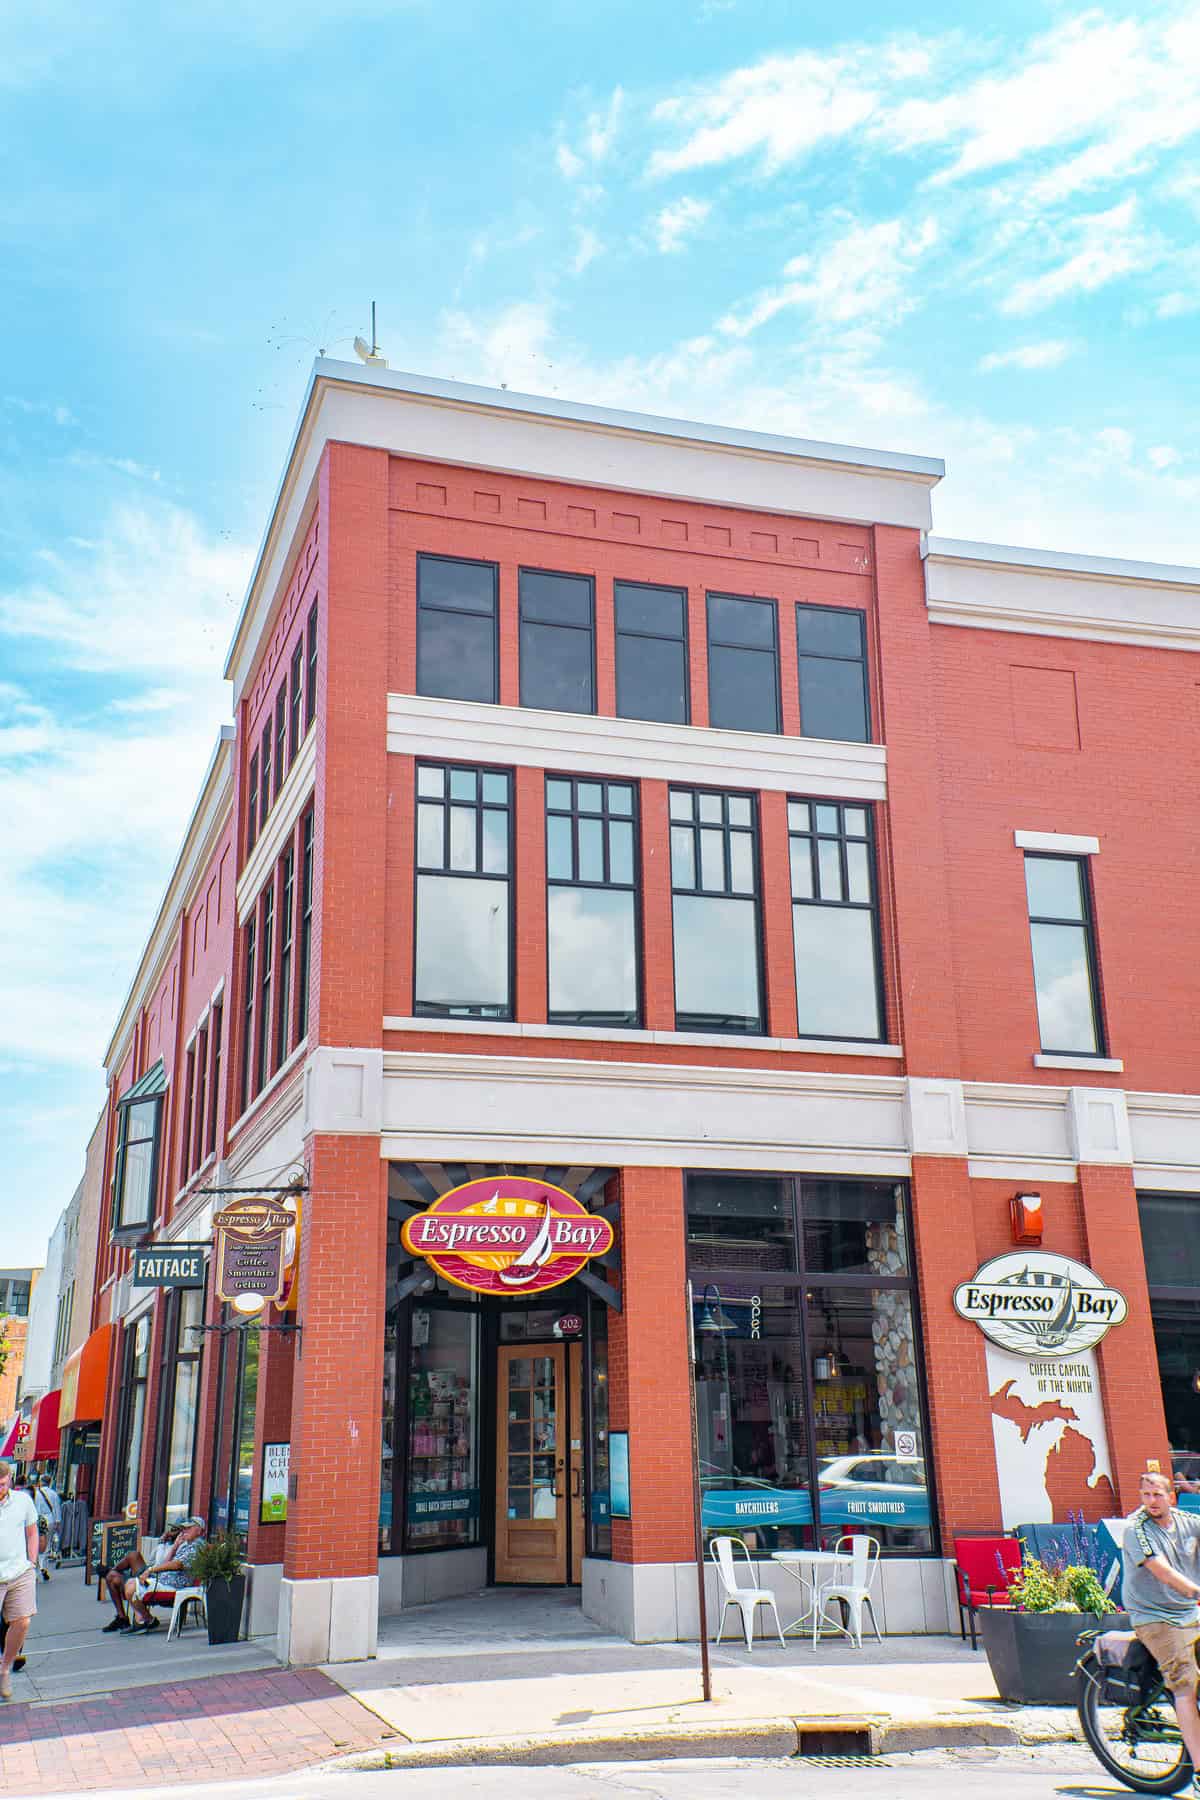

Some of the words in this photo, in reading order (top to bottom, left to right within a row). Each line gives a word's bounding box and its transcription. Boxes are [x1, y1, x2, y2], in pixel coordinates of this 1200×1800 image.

[217, 1213, 262, 1226] Espresso
[272, 1214, 291, 1225] Bay
[420, 1217, 526, 1249] Espresso
[553, 1220, 603, 1252] Bay
[138, 1258, 199, 1278] FATFACE
[236, 1259, 268, 1267] Coffee
[227, 1269, 275, 1278] Smoothies
[235, 1280, 266, 1289] Gelato
[965, 1288, 1054, 1316] Espresso
[1076, 1292, 1118, 1320] Bay
[562, 1319, 578, 1329] 202
[1029, 1363, 1057, 1377] COFFEE
[1059, 1364, 1091, 1378] CAPITAL
[1038, 1380, 1047, 1393] OF
[1051, 1380, 1065, 1393] THE
[1067, 1381, 1093, 1394] NORTH
[735, 1501, 779, 1515] BAYCHILLERS
[847, 1502, 867, 1514] FRUIT
[868, 1502, 906, 1514] SMOOTHIES
